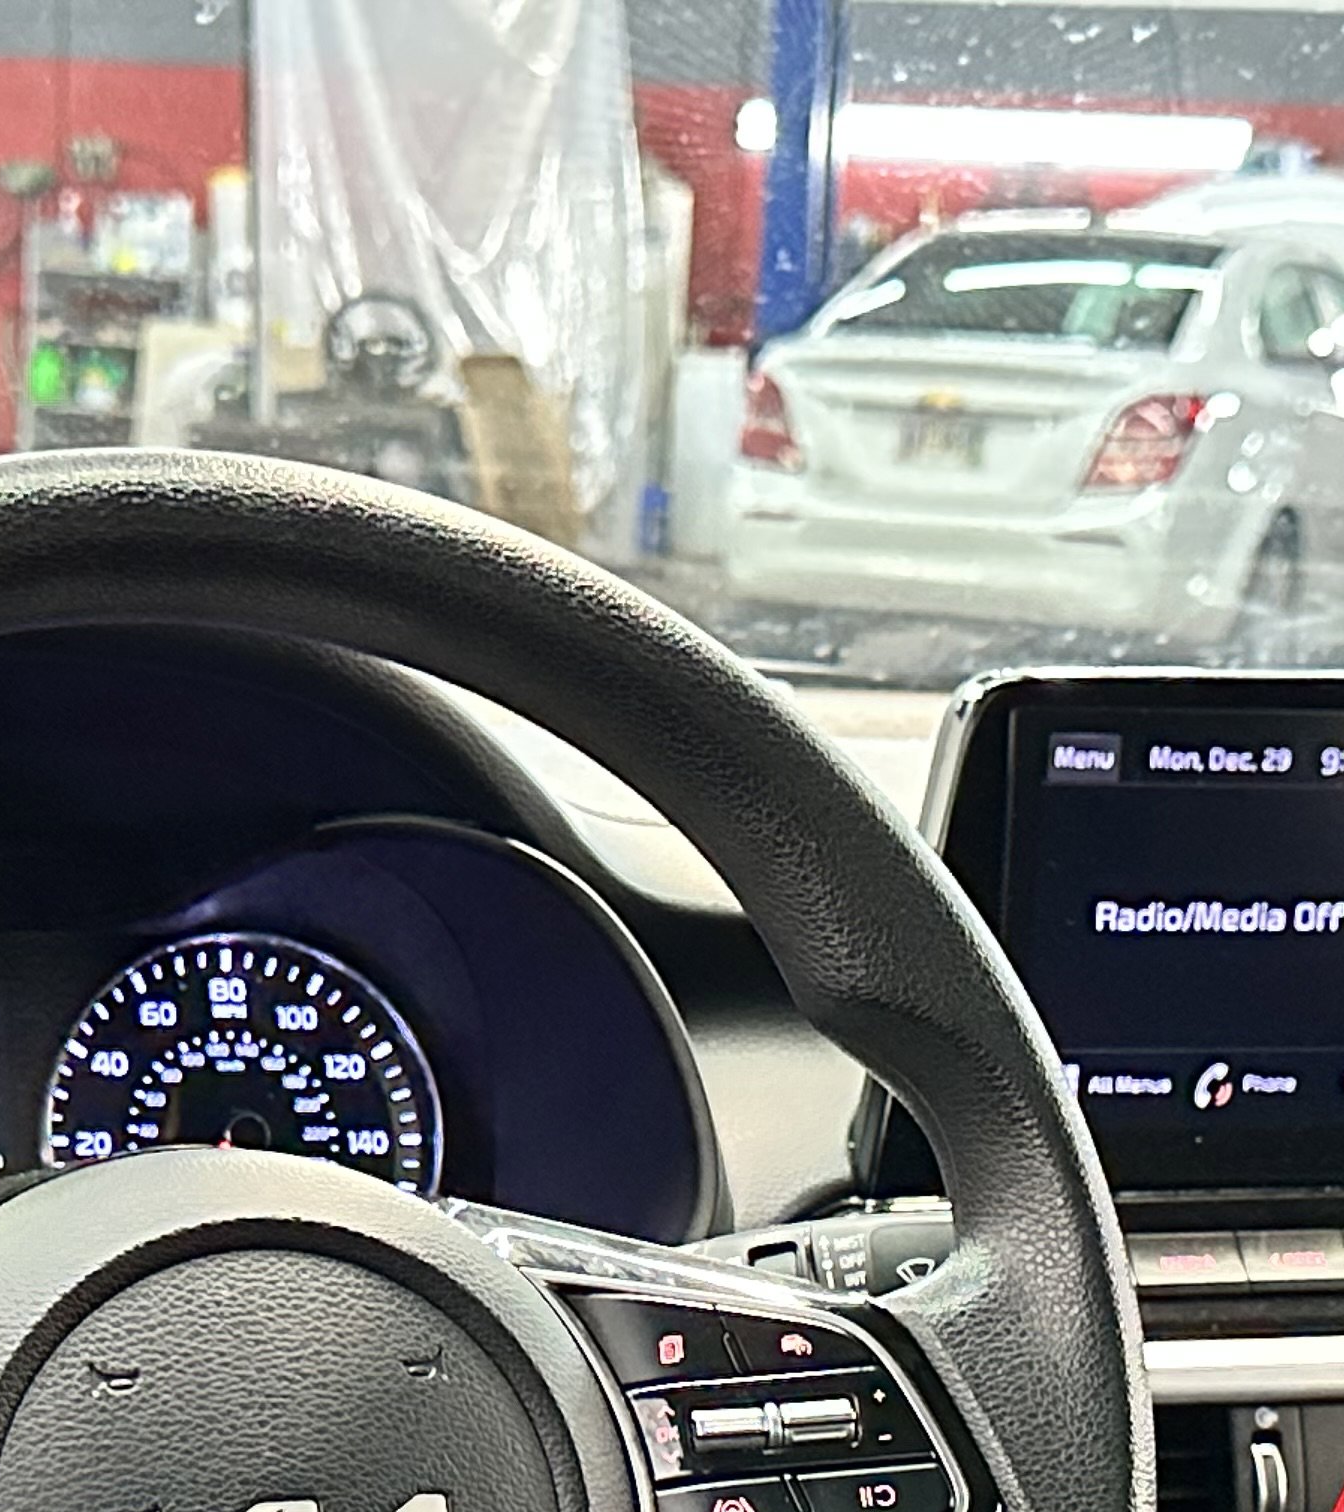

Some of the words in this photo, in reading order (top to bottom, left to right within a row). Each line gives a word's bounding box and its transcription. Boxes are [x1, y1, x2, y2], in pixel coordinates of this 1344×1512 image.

[1053, 746, 1115, 770] Menu
[1262, 747, 1293, 772] 29
[1094, 902, 1287, 933] Radio/Media
[208, 977, 246, 1002] 80
[139, 1001, 177, 1027] 60
[275, 1005, 318, 1031] 100
[90, 1051, 129, 1078] 40
[323, 1054, 366, 1080] 120
[74, 1131, 113, 1157] 20
[346, 1129, 389, 1156] 140
[838, 1251, 867, 1270] OFF
